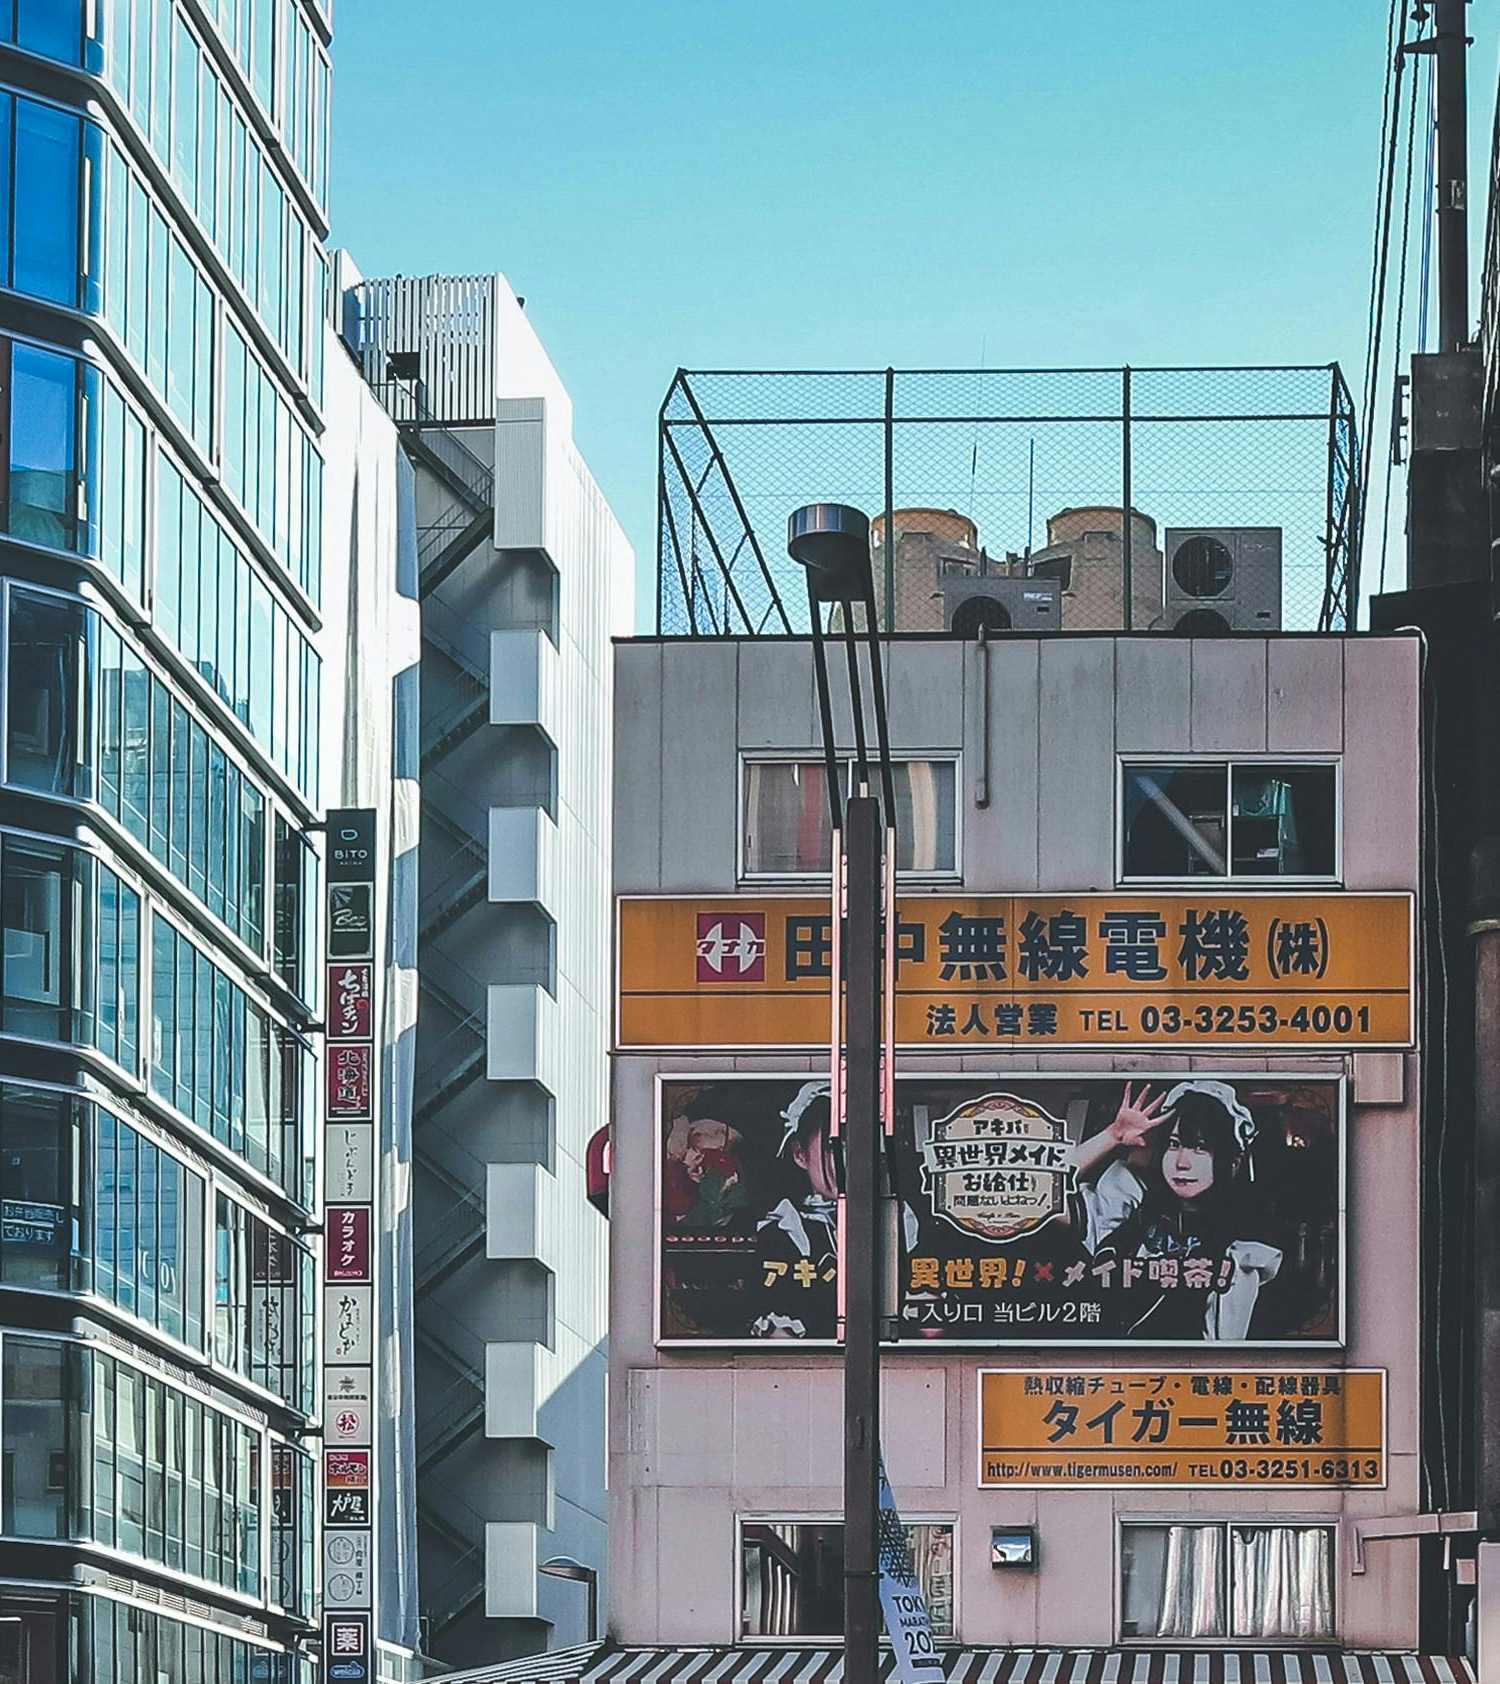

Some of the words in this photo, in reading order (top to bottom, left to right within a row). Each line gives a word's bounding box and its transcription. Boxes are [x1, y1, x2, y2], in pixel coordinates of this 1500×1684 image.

[334, 849, 368, 860] BITO
[926, 1003, 1058, 1037] 法人営業
[1080, 1011, 1128, 1033] TEL
[1140, 1004, 1373, 1035] 03-3253-4001
[3, 1225, 55, 1243] ております
[341, 1211, 356, 1267] カラオケ
[909, 1257, 1023, 1289] 異世界!
[1061, 1257, 1233, 1291] メイド喫茶!
[921, 1302, 984, 1323] 入り口
[992, 1301, 1102, 1324] 当ビル2階
[1042, 1398, 1325, 1445] タイガー無線
[986, 1462, 1178, 1480] http://www.tigermusen.com/
[1189, 1464, 1218, 1478] TEL
[1219, 1458, 1380, 1480] 03-3251-6313
[891, 1595, 925, 1613] TOK
[336, 1627, 358, 1651] 薬
